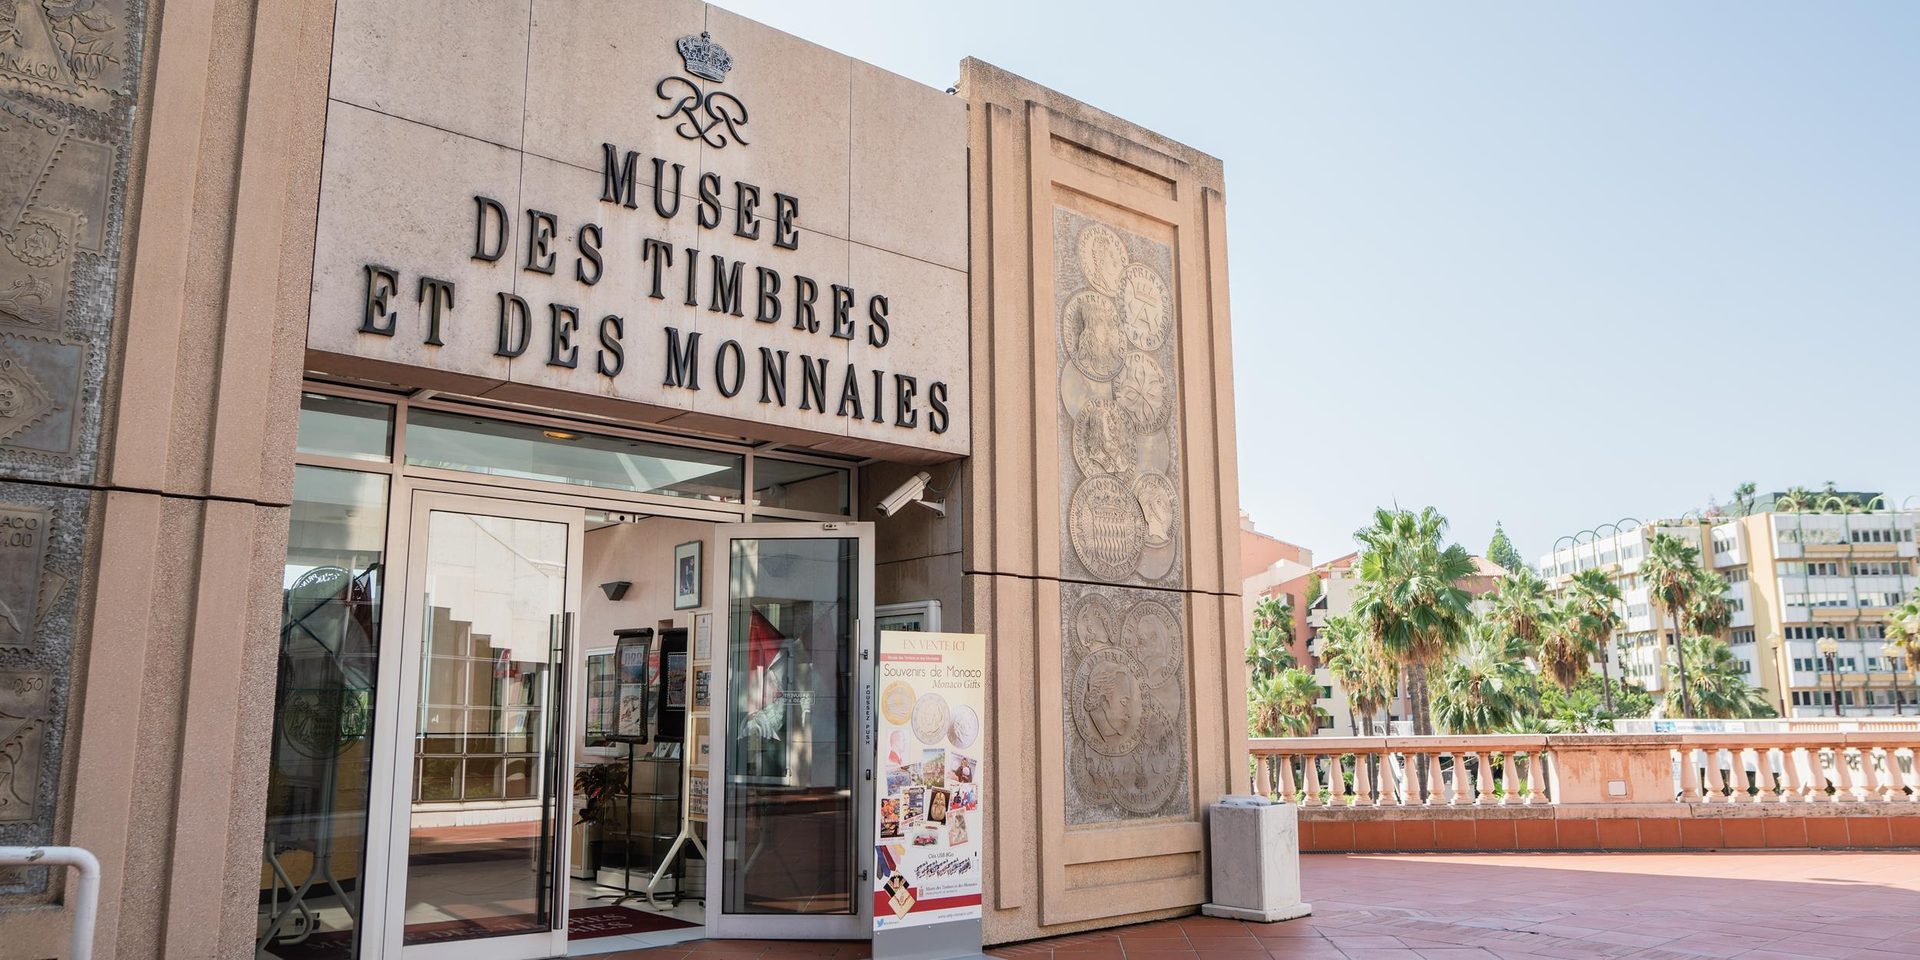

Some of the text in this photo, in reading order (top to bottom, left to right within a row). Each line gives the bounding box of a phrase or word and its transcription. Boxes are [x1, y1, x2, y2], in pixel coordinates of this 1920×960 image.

[600, 142, 799, 250] MUSEE
[471, 195, 890, 348] DES TIMBRES
[358, 264, 950, 434] ET DES MONNAIES
[884, 663, 982, 678] Souvenirs de Monaco
[952, 641, 965, 651] ICI
[932, 679, 981, 689] Monaco Gifts
